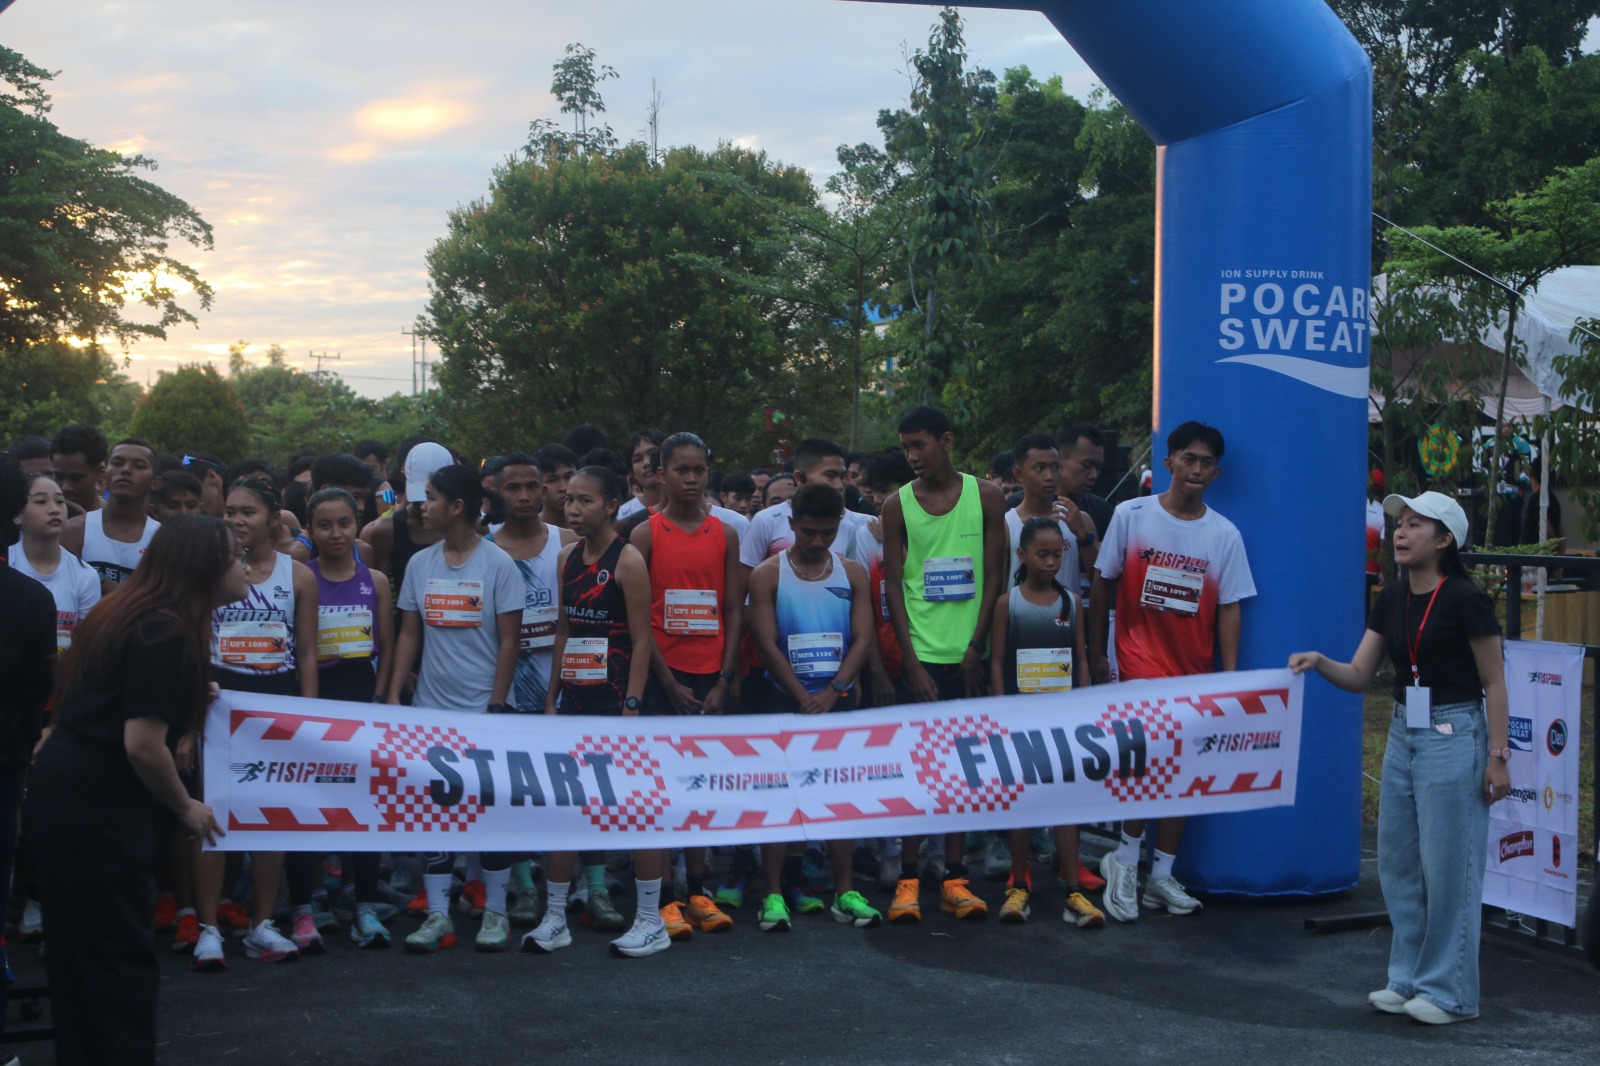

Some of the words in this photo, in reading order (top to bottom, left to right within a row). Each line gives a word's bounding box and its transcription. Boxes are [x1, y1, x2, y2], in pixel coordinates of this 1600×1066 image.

[1221, 270, 1241, 278] ION
[1245, 269, 1288, 279] SUPPLY
[1291, 270, 1324, 279] DRINK
[1218, 317, 1366, 354] SWEAT
[1152, 550, 1186, 569] FISIP
[1153, 584, 1168, 593] UPA
[953, 718, 1148, 788] FINISH
[1217, 732, 1254, 753] FISIP
[265, 761, 318, 783] FISIP
[317, 762, 358, 777] RUN5K
[426, 745, 618, 807] START
[709, 772, 752, 791] FISIP
[752, 771, 788, 784] RUN5K
[823, 764, 867, 785] FISIP
[867, 762, 902, 776] RUN5K
